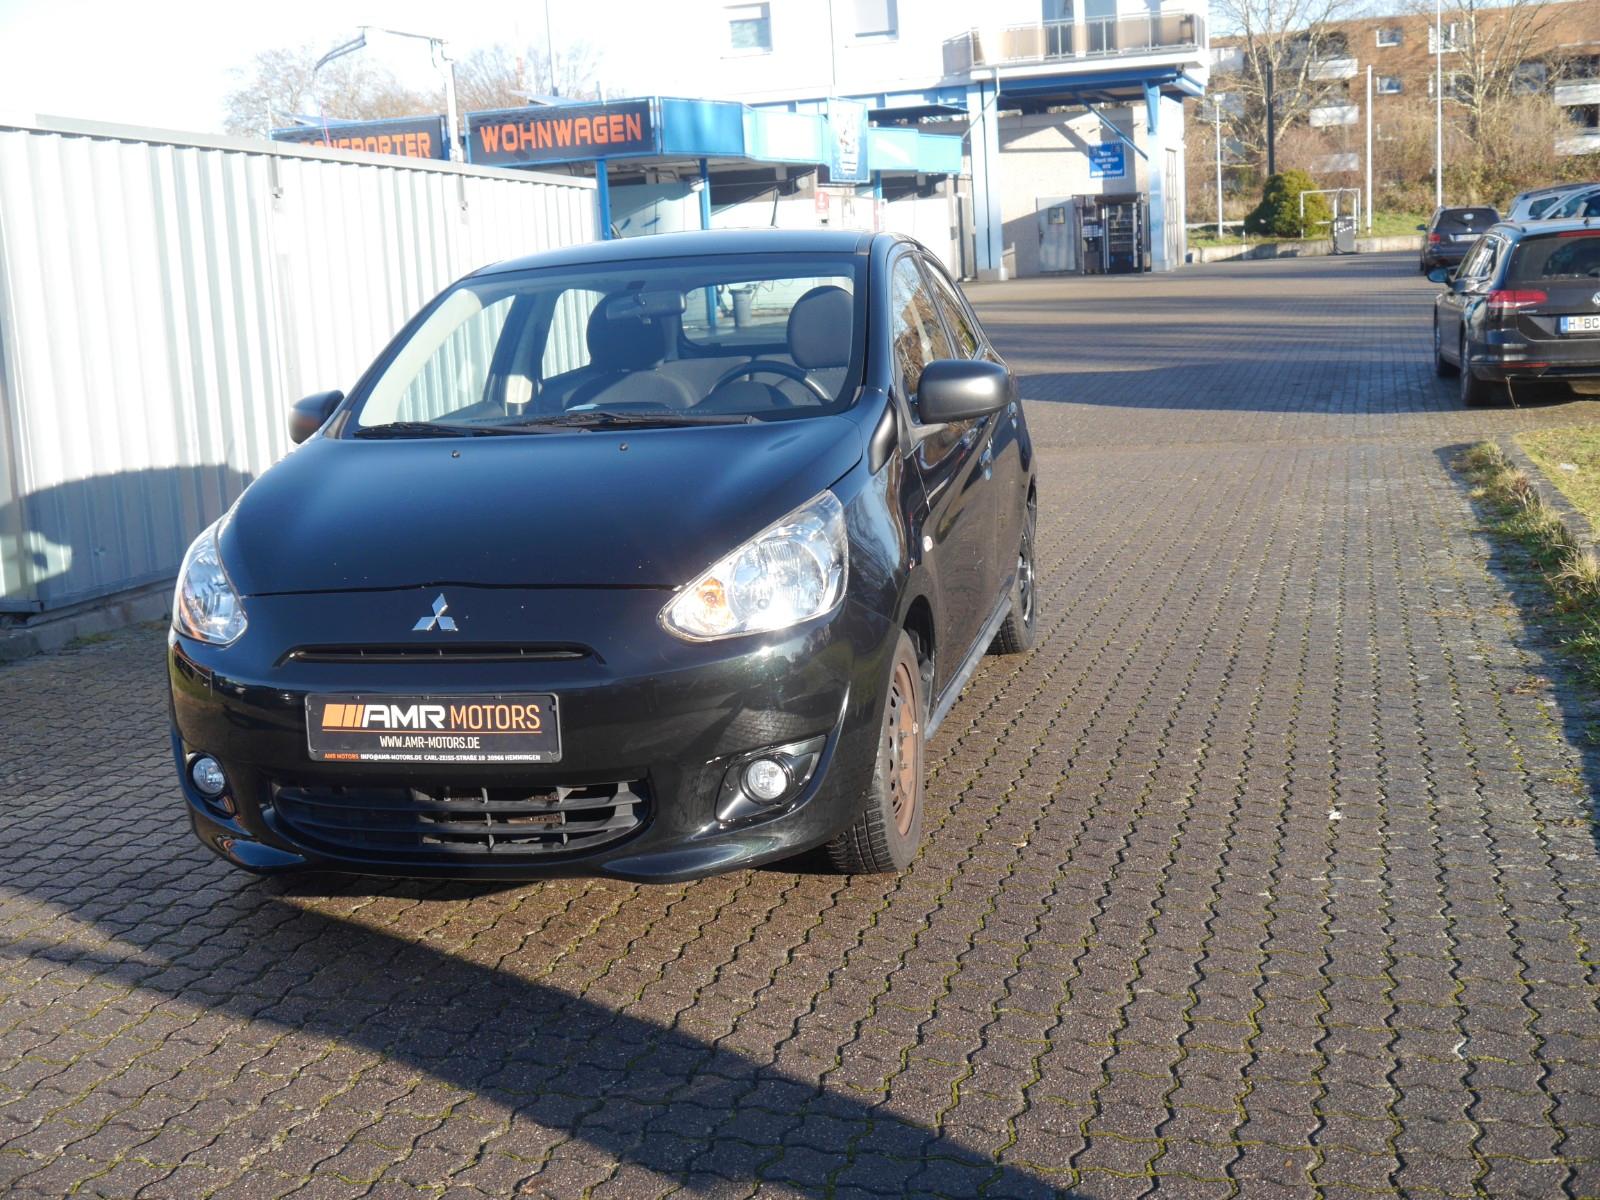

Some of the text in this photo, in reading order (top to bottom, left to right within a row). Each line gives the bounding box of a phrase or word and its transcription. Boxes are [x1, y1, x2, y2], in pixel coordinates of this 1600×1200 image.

[480, 113, 642, 153] WOHNWAGEN
[1568, 320, 1576, 329] H
[361, 704, 541, 730] AMR MOTORS
[379, 735, 481, 749] WWW.AMR-MOTORS.DE
[360, 753, 422, 761] INFO@AMR-MOTORS.DE
